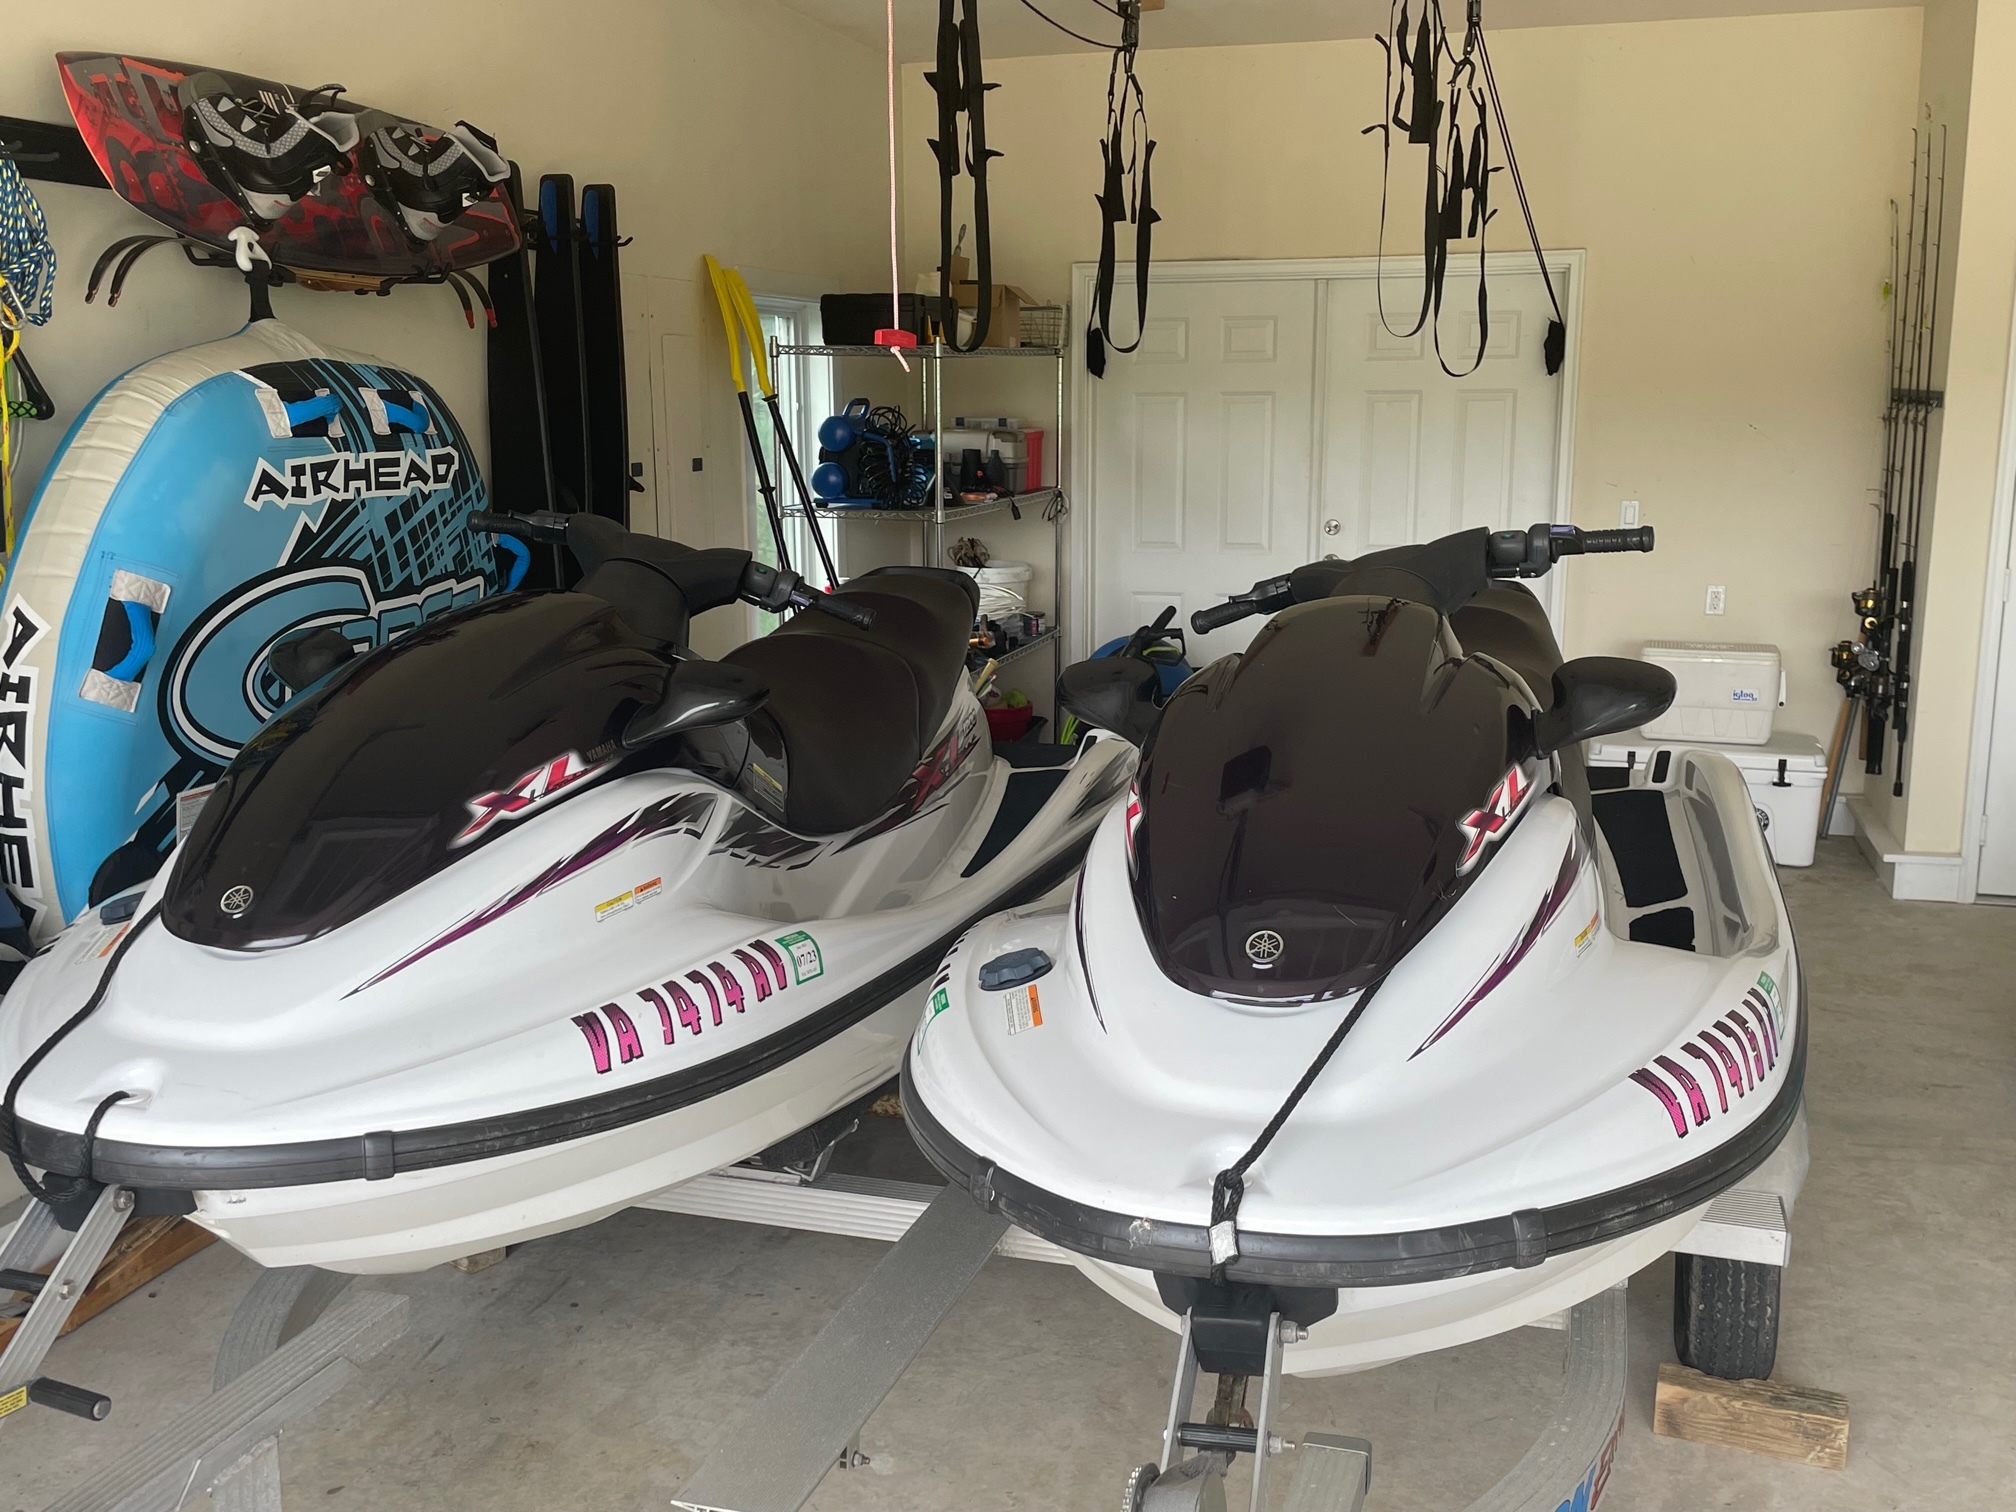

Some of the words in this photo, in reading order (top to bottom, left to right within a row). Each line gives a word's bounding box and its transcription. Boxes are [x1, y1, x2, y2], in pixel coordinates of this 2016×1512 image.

[249, 450, 457, 505] AIRHEAD
[586, 739, 617, 762] YAMAHA
[458, 752, 607, 842] XL
[1460, 767, 1534, 864] XL
[796, 949, 818, 968] 07/23
[571, 1002, 644, 1074] VA
[636, 961, 745, 1046] 7474
